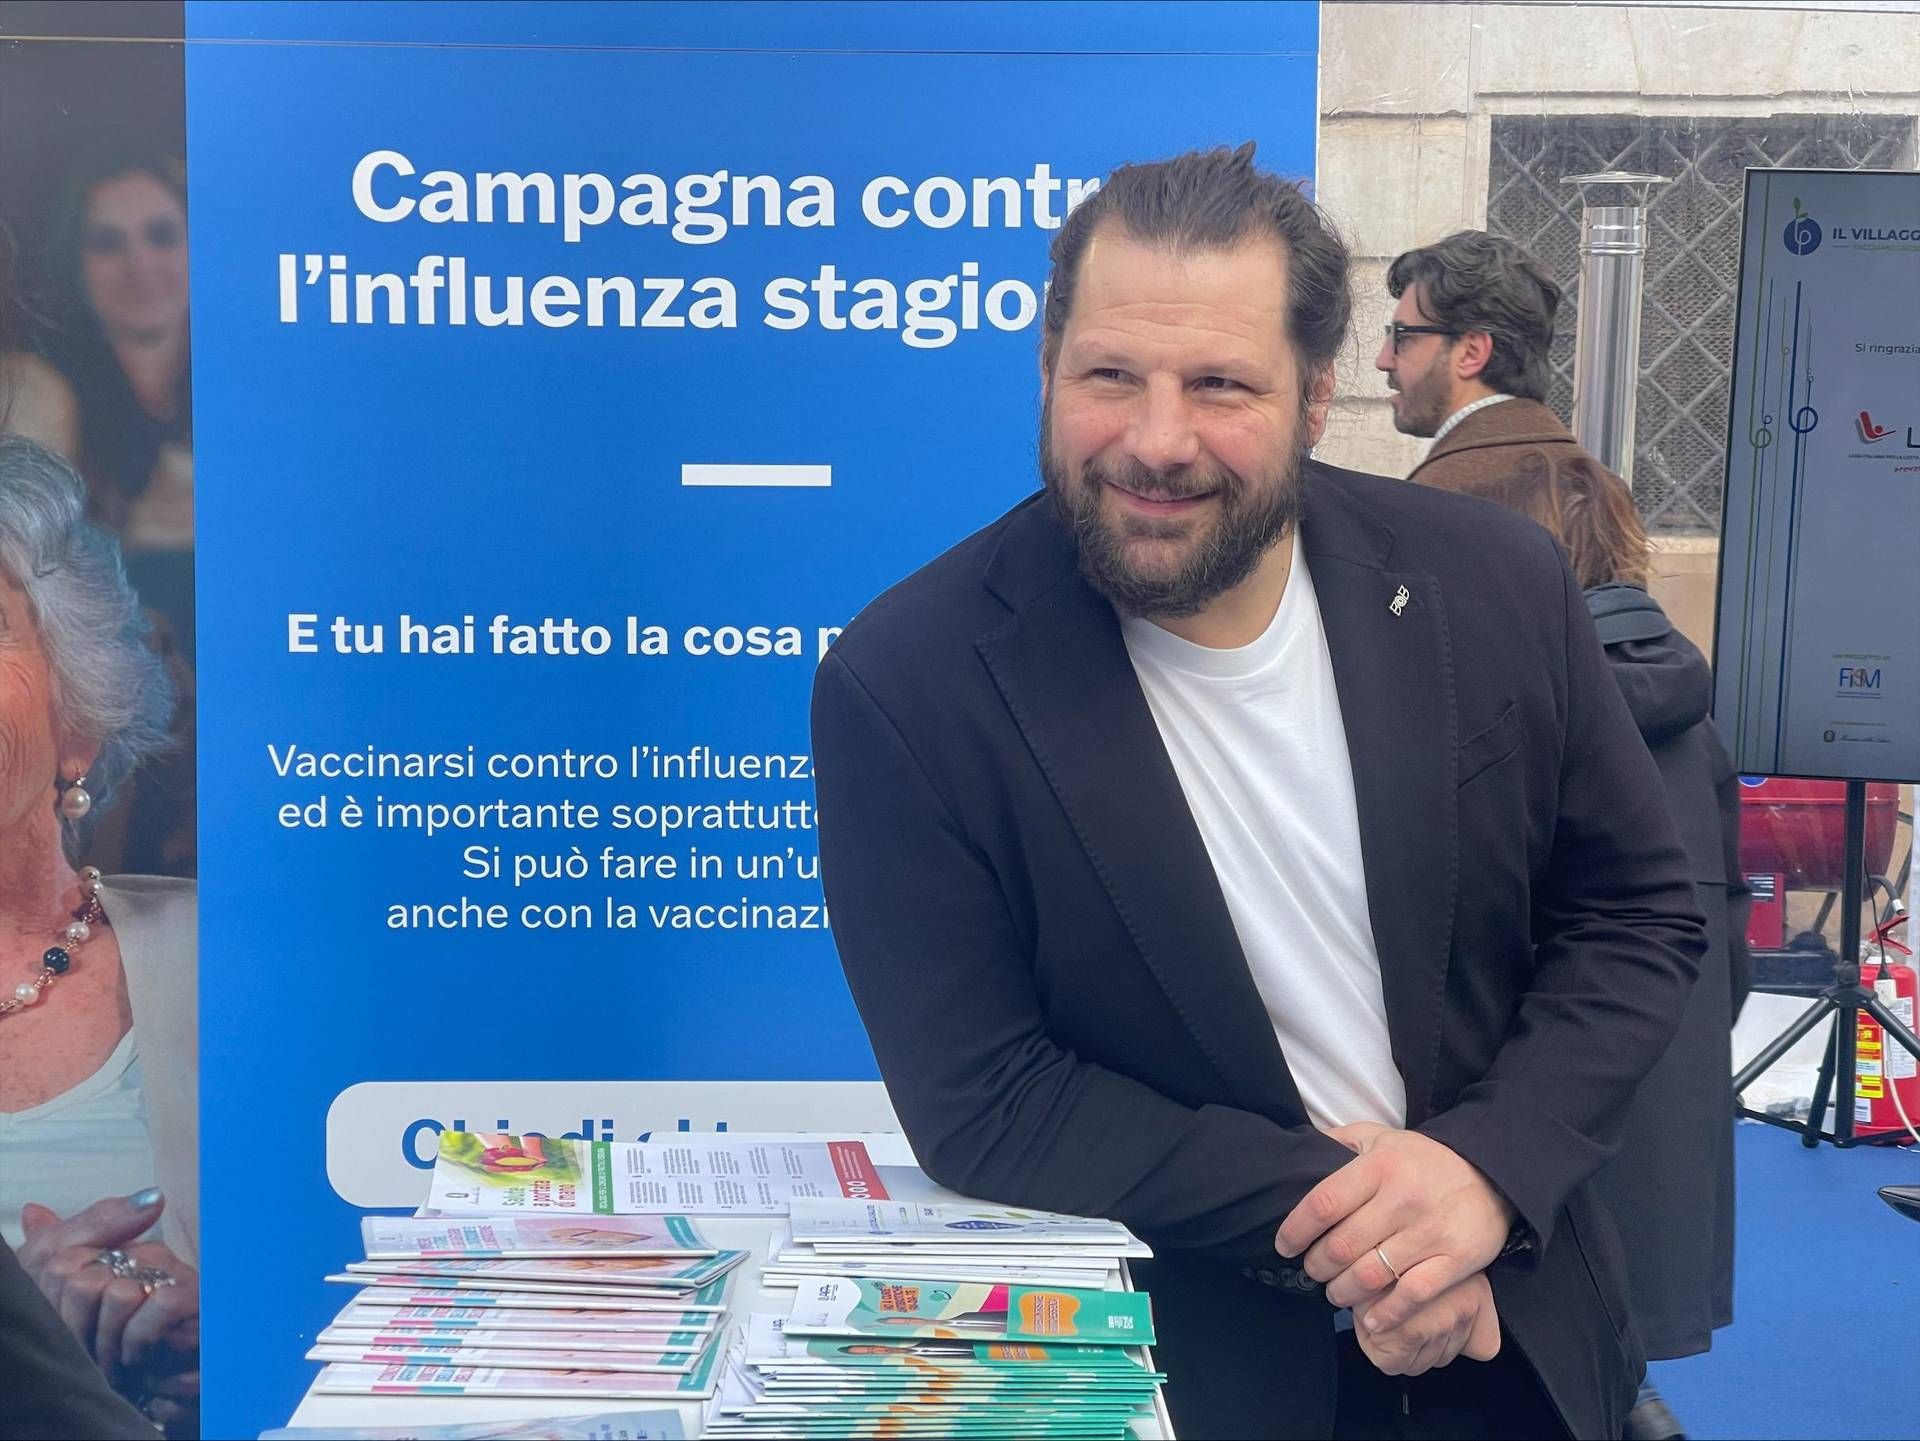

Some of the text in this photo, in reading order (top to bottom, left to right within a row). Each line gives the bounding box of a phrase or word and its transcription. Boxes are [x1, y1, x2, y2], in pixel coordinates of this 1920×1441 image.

[353, 150, 834, 245] Campagna
[1832, 227, 1920, 242] IL VILLAGG
[279, 254, 1053, 349] l’influenza stagio
[1855, 342, 1867, 354] Si
[288, 613, 856, 664] E tu hai fatto la cosa p
[268, 744, 475, 778] Vaccinarsi
[488, 748, 618, 779] contro
[278, 796, 820, 837] ed è importante soprattutt
[463, 846, 500, 879] Si
[515, 847, 588, 887] può
[599, 846, 677, 879] fare
[691, 847, 722, 878] in
[387, 896, 508, 929] anche
[521, 905, 592, 929] con
[607, 896, 636, 929] la
